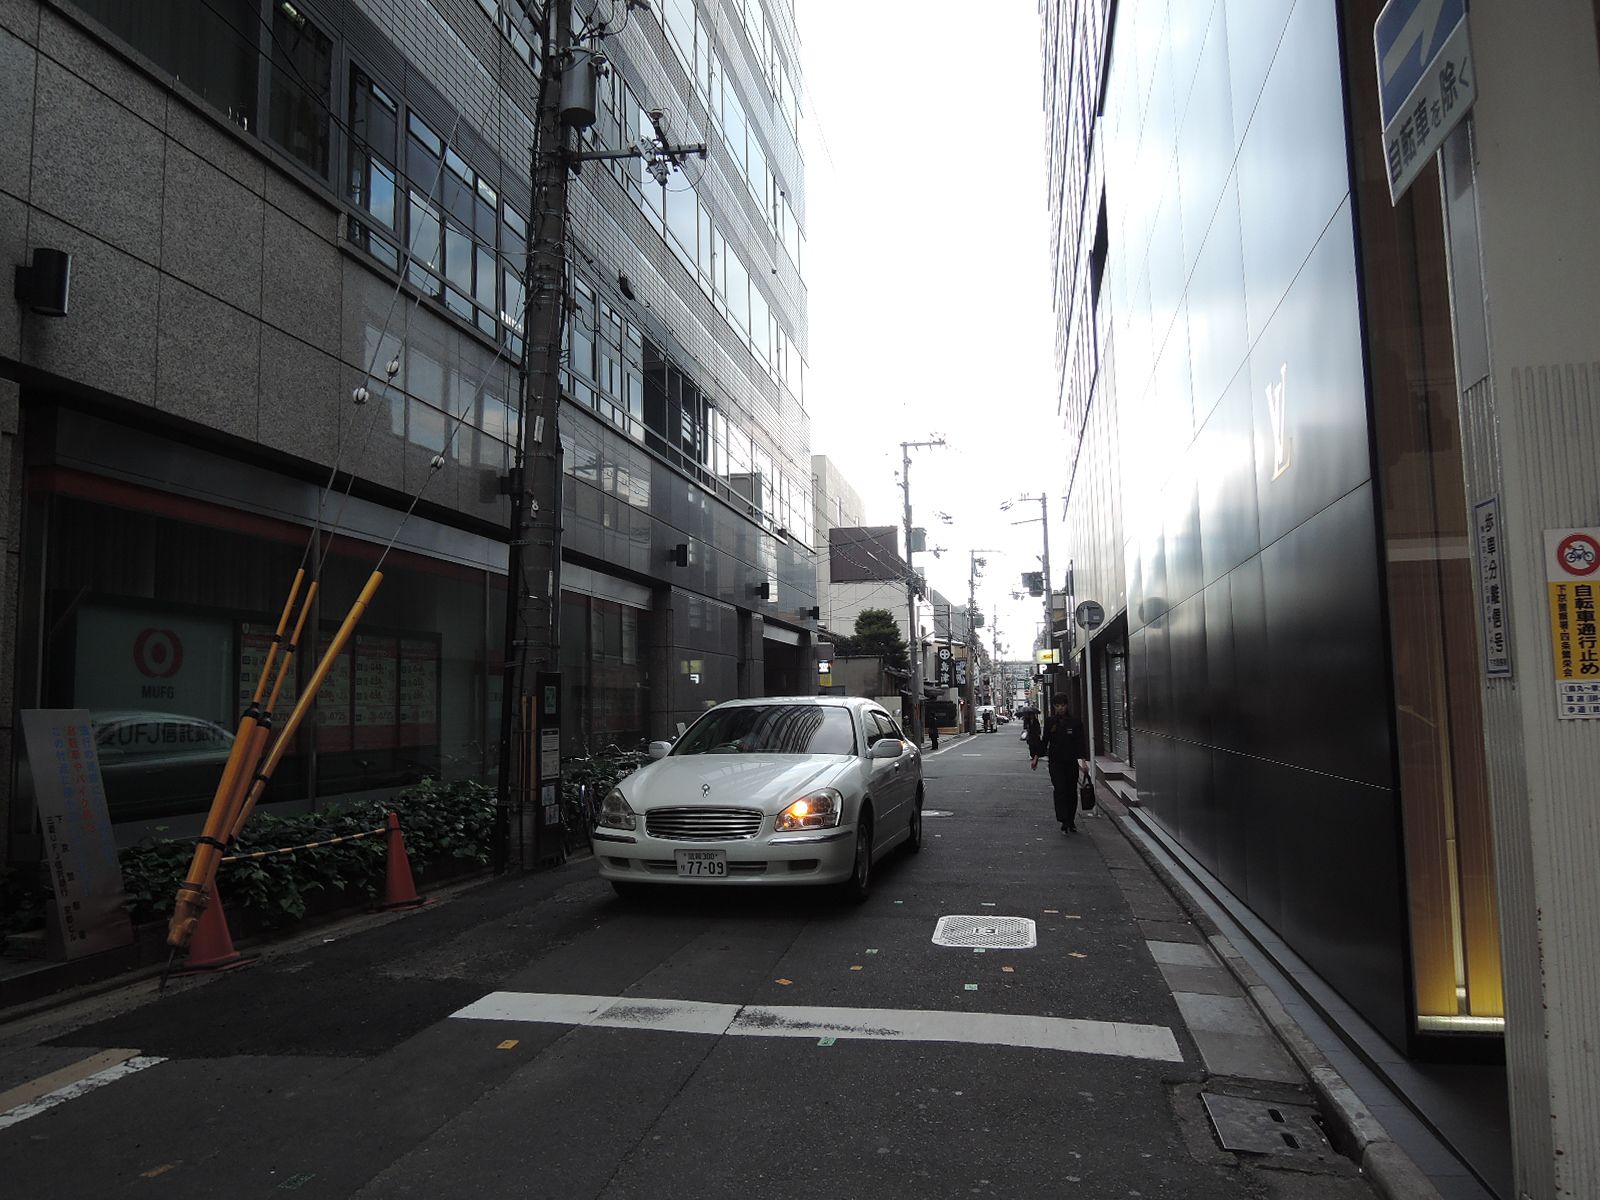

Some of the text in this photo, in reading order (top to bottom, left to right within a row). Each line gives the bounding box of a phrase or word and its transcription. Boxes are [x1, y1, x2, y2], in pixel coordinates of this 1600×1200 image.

[1387, 56, 1470, 185] 自転車を除く
[1574, 584, 1600, 675] 自転車通行止め
[141, 686, 175, 699] MUFG
[687, 861, 724, 875] 77-09
